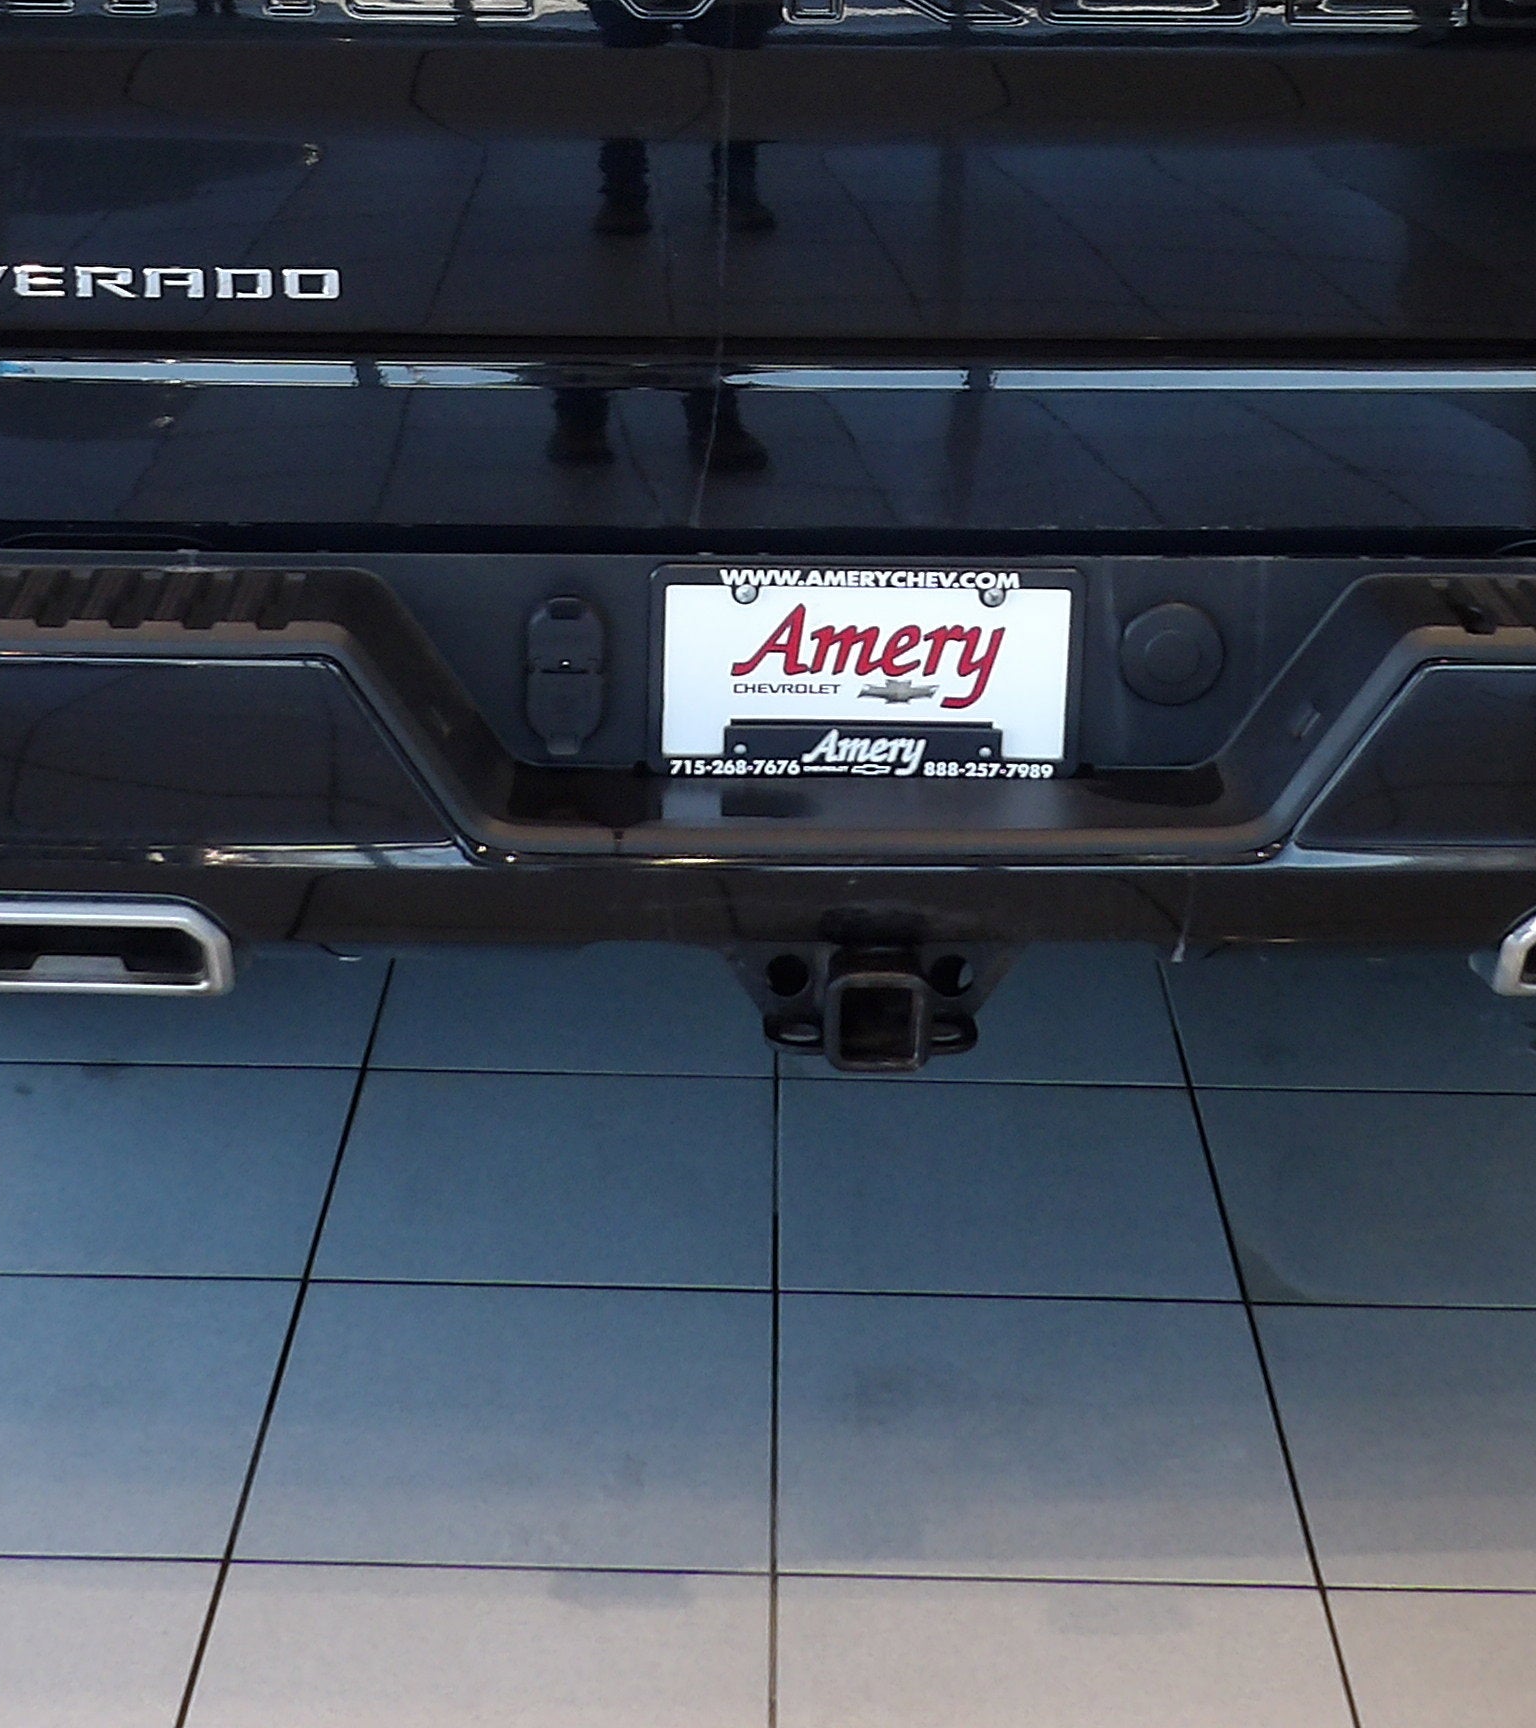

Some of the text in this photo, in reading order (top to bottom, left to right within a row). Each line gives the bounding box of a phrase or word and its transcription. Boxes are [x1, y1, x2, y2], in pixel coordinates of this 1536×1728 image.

[720, 569, 1020, 589] WWW.AMERYCHEV.COM
[731, 603, 1006, 710] Amery
[733, 682, 841, 695] CHEVROLET
[802, 728, 927, 776] Amery
[670, 759, 801, 776] 715-268-7676
[923, 761, 1054, 779] 888-257-7989
